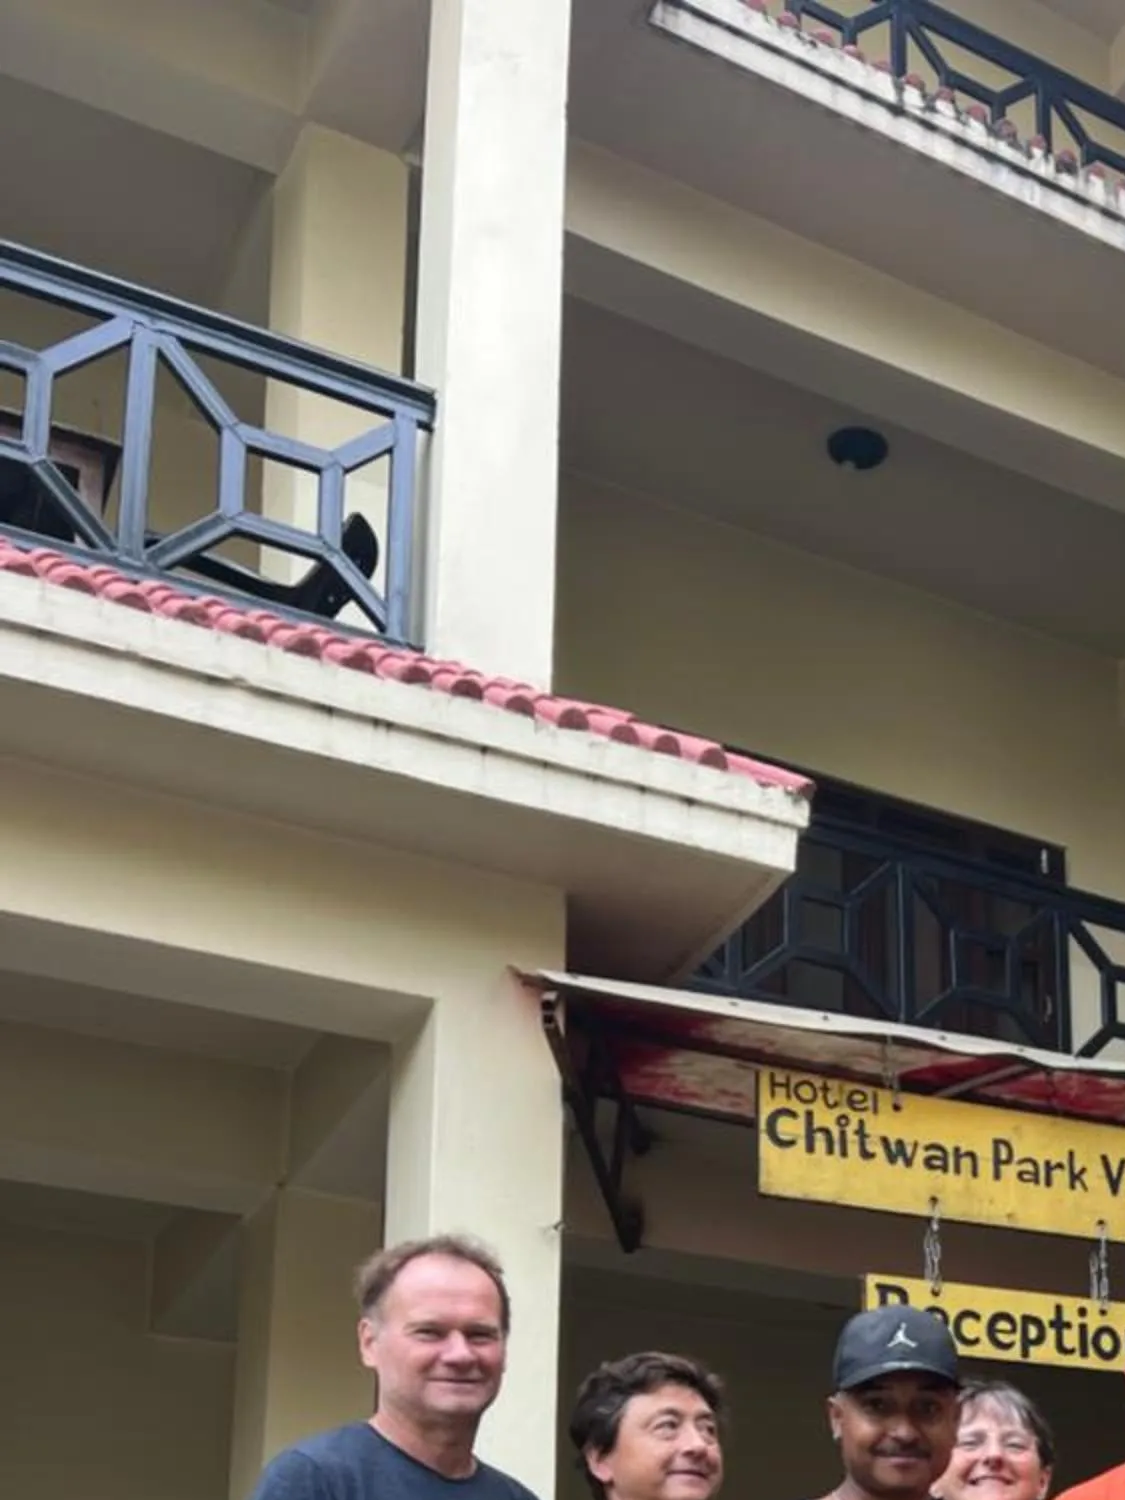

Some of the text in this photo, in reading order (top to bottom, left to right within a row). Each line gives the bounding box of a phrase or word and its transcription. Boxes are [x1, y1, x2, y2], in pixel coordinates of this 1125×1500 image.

[769, 1072, 879, 1115] Hotel
[766, 1107, 979, 1178] Chitwan
[992, 1138, 1088, 1192] Park
